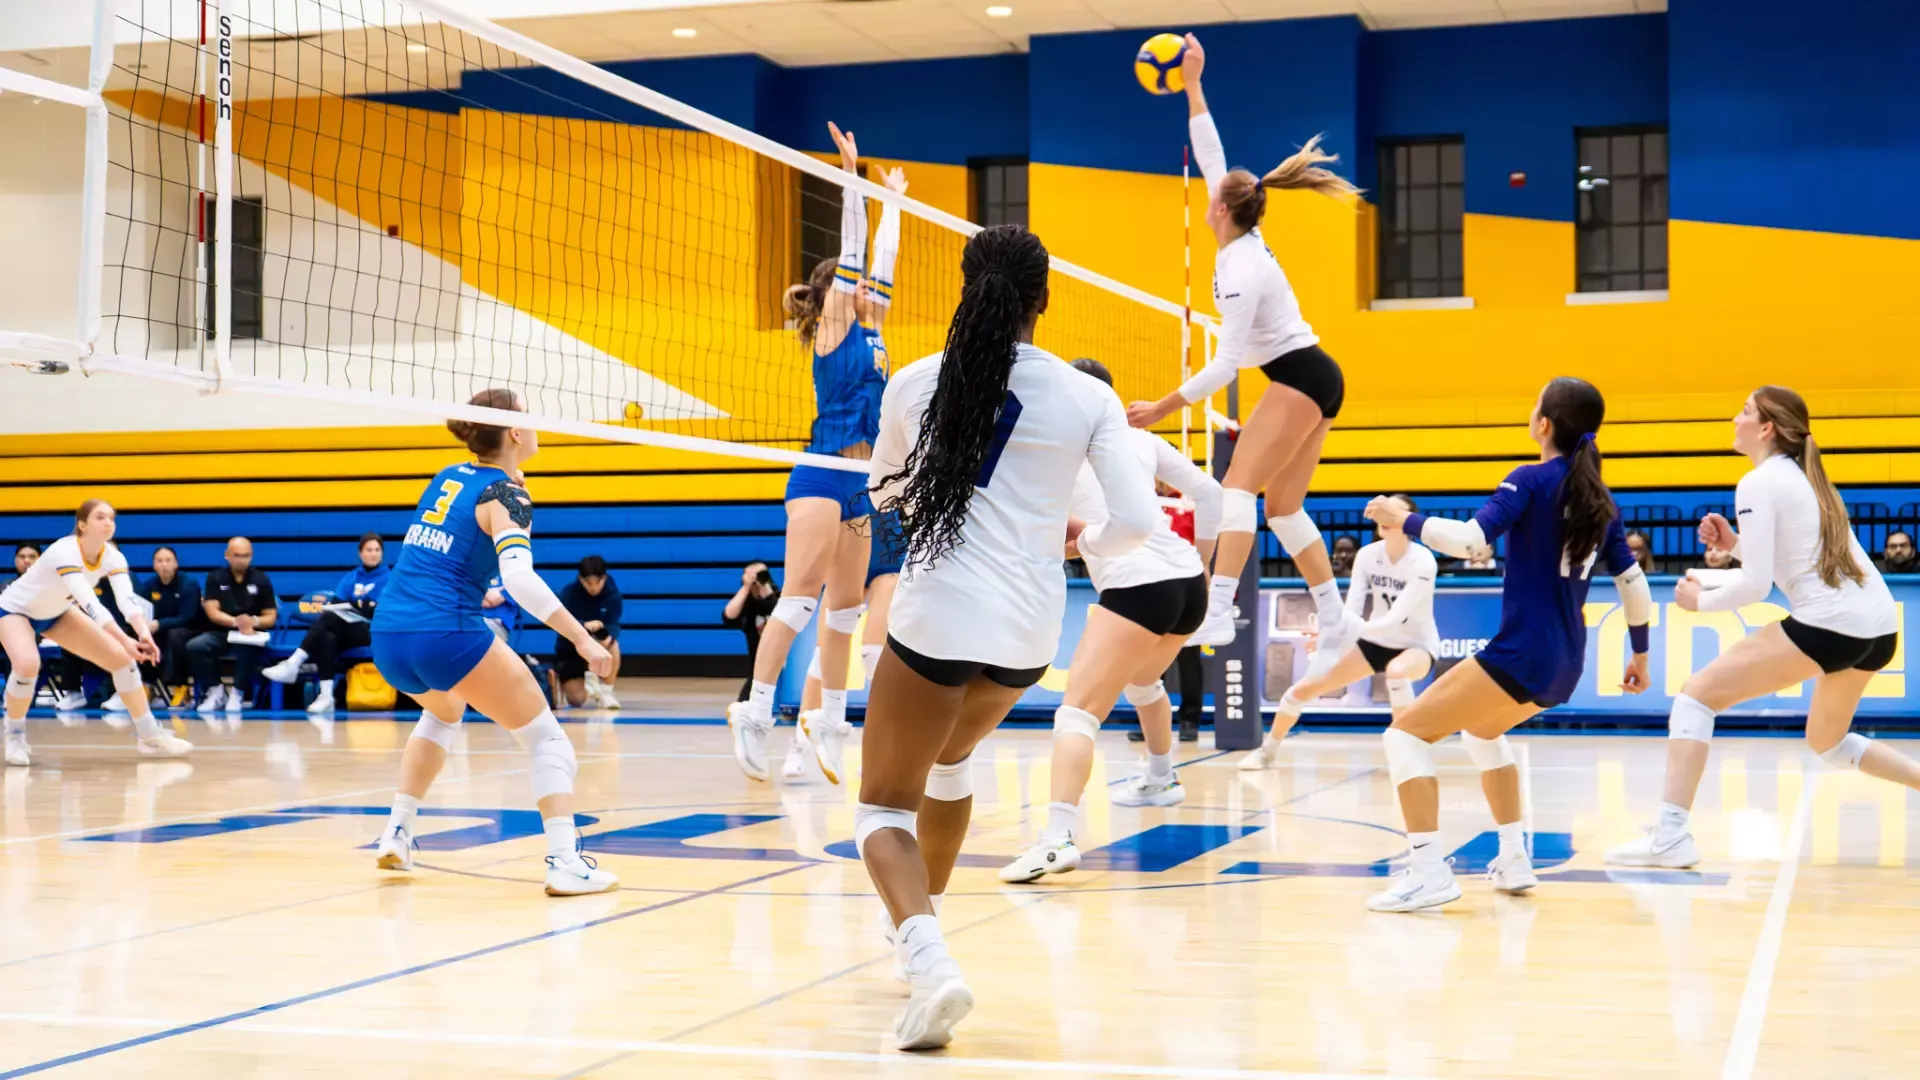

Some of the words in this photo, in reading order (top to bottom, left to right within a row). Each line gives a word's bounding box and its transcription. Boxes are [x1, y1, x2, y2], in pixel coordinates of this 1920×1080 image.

[219, 15, 231, 120] Senoh
[421, 479, 464, 525] 3
[403, 524, 454, 554] KRAHN
[1439, 638, 1493, 658] GUES
